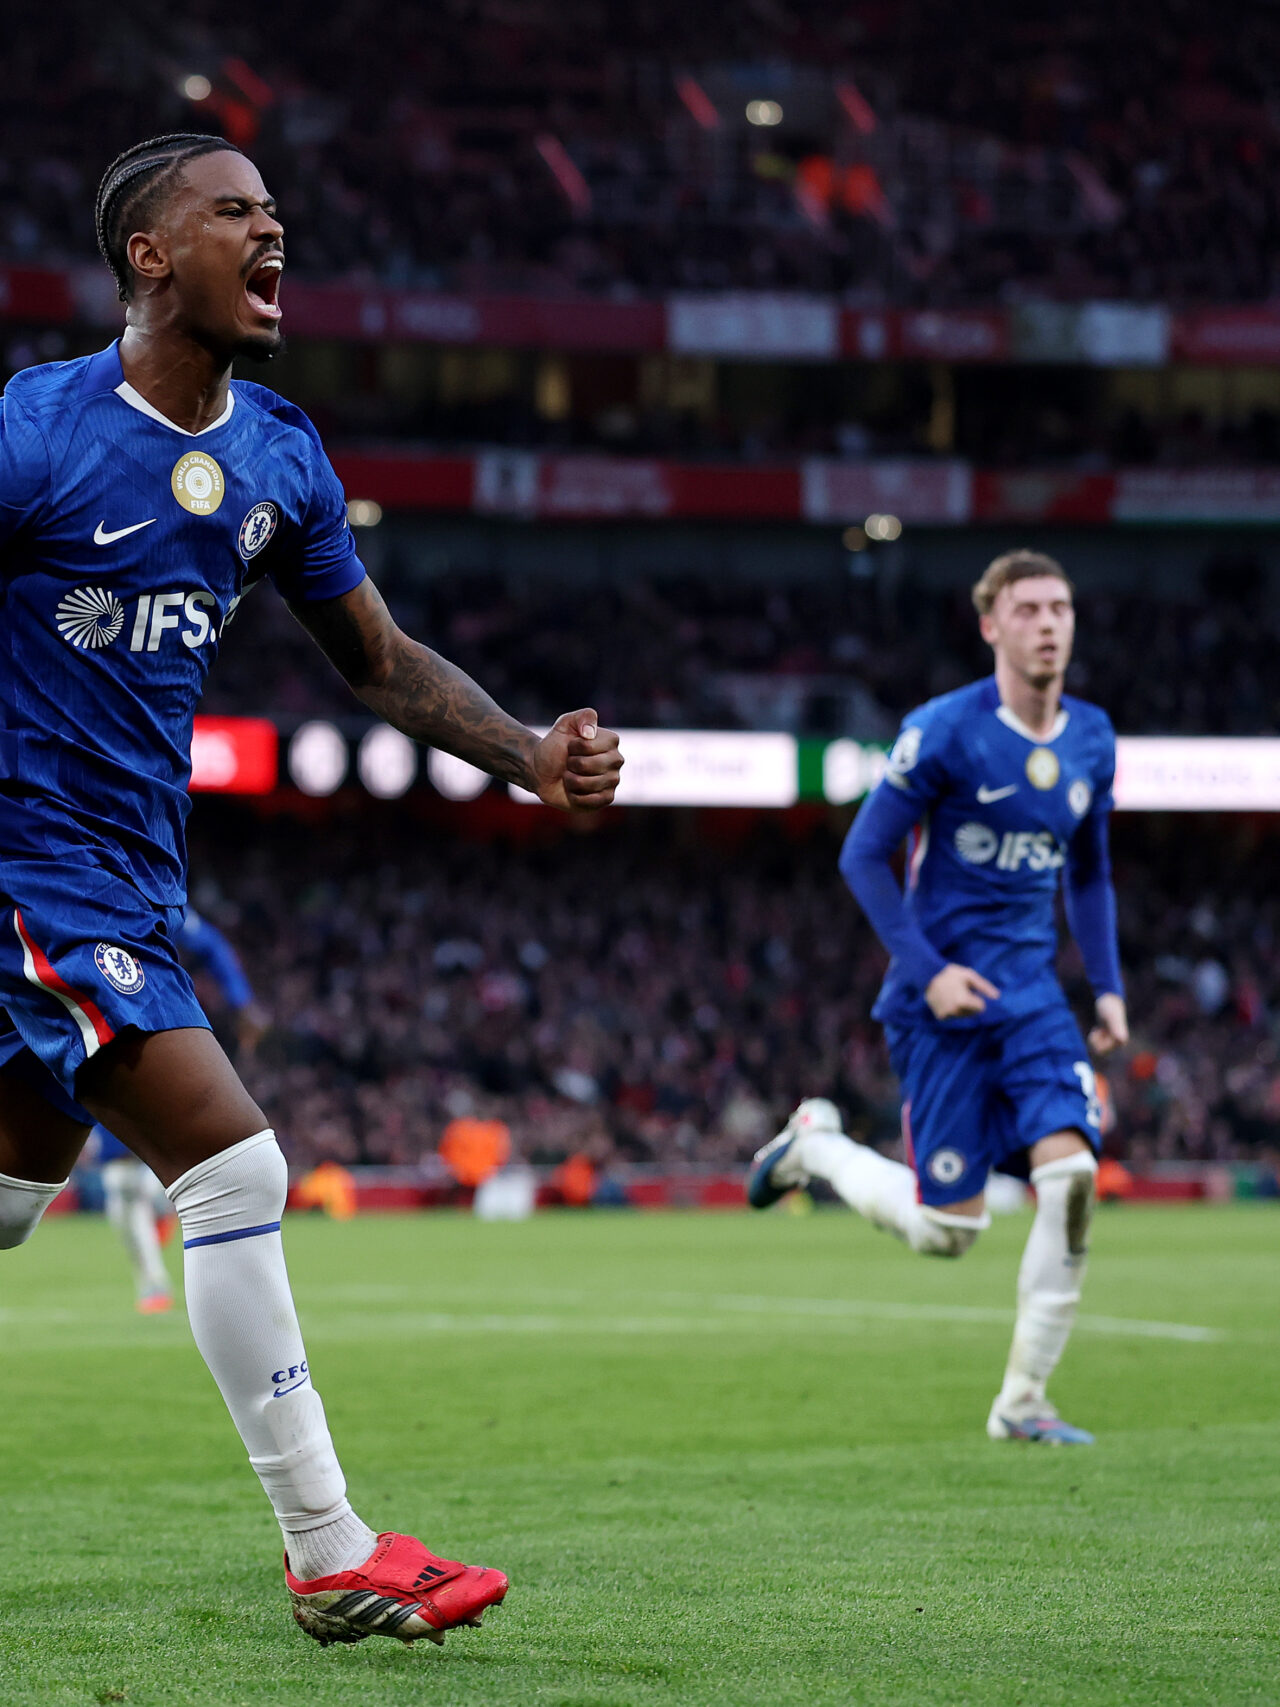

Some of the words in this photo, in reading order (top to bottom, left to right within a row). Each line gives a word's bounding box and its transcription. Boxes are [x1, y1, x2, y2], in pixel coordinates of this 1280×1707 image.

[176, 461, 190, 490] WORLD
[189, 457, 221, 491] CHAMPIONS
[190, 500, 211, 510] FIFA
[250, 503, 275, 517] CHELSEA
[271, 1360, 308, 1384] CFC
